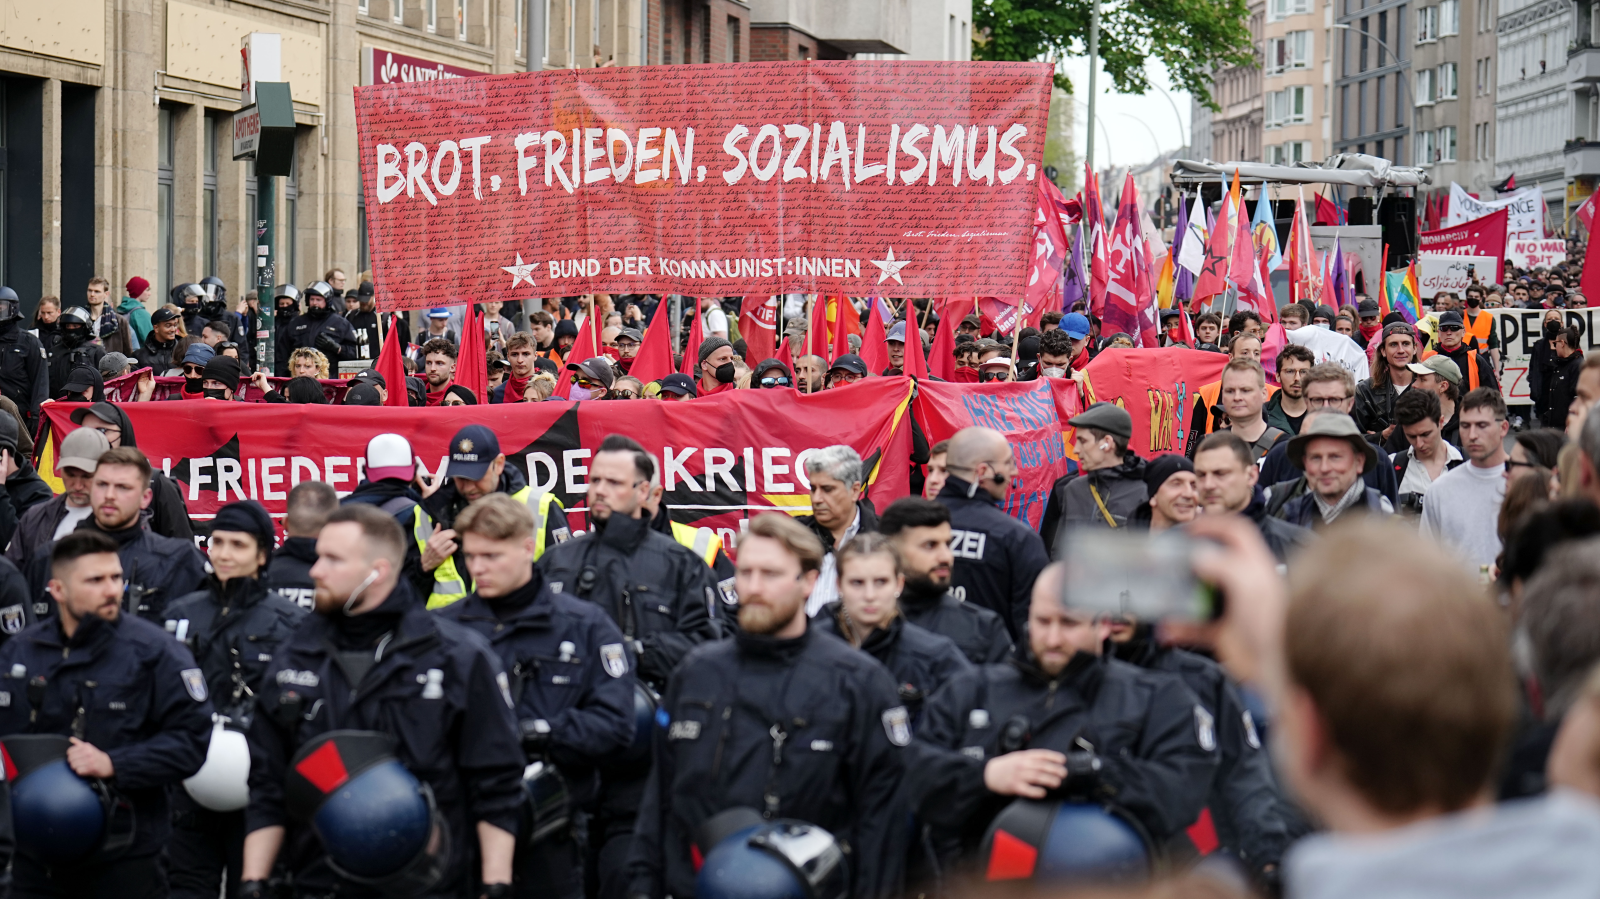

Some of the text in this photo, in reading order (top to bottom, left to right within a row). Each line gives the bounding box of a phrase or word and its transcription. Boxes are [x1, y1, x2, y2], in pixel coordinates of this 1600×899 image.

[235, 112, 260, 141] APOTHEKE
[376, 120, 1036, 206] BROT. FRIEDEN. SOZIALISMUS.
[1457, 195, 1483, 215] YOUR
[902, 229, 1009, 242] Brot. Frieden. Sozialismus.
[1421, 230, 1469, 245] MONARCHY
[1515, 241, 1566, 253] NO WAR
[549, 256, 861, 279] BUND DER KOMMUNIST:INNEN
[1525, 255, 1553, 266] BUT
[961, 394, 1015, 431] IHRE
[453, 453, 478, 462] POLIZEI
[1019, 441, 1042, 469] AUF
[526, 448, 592, 494] DE
